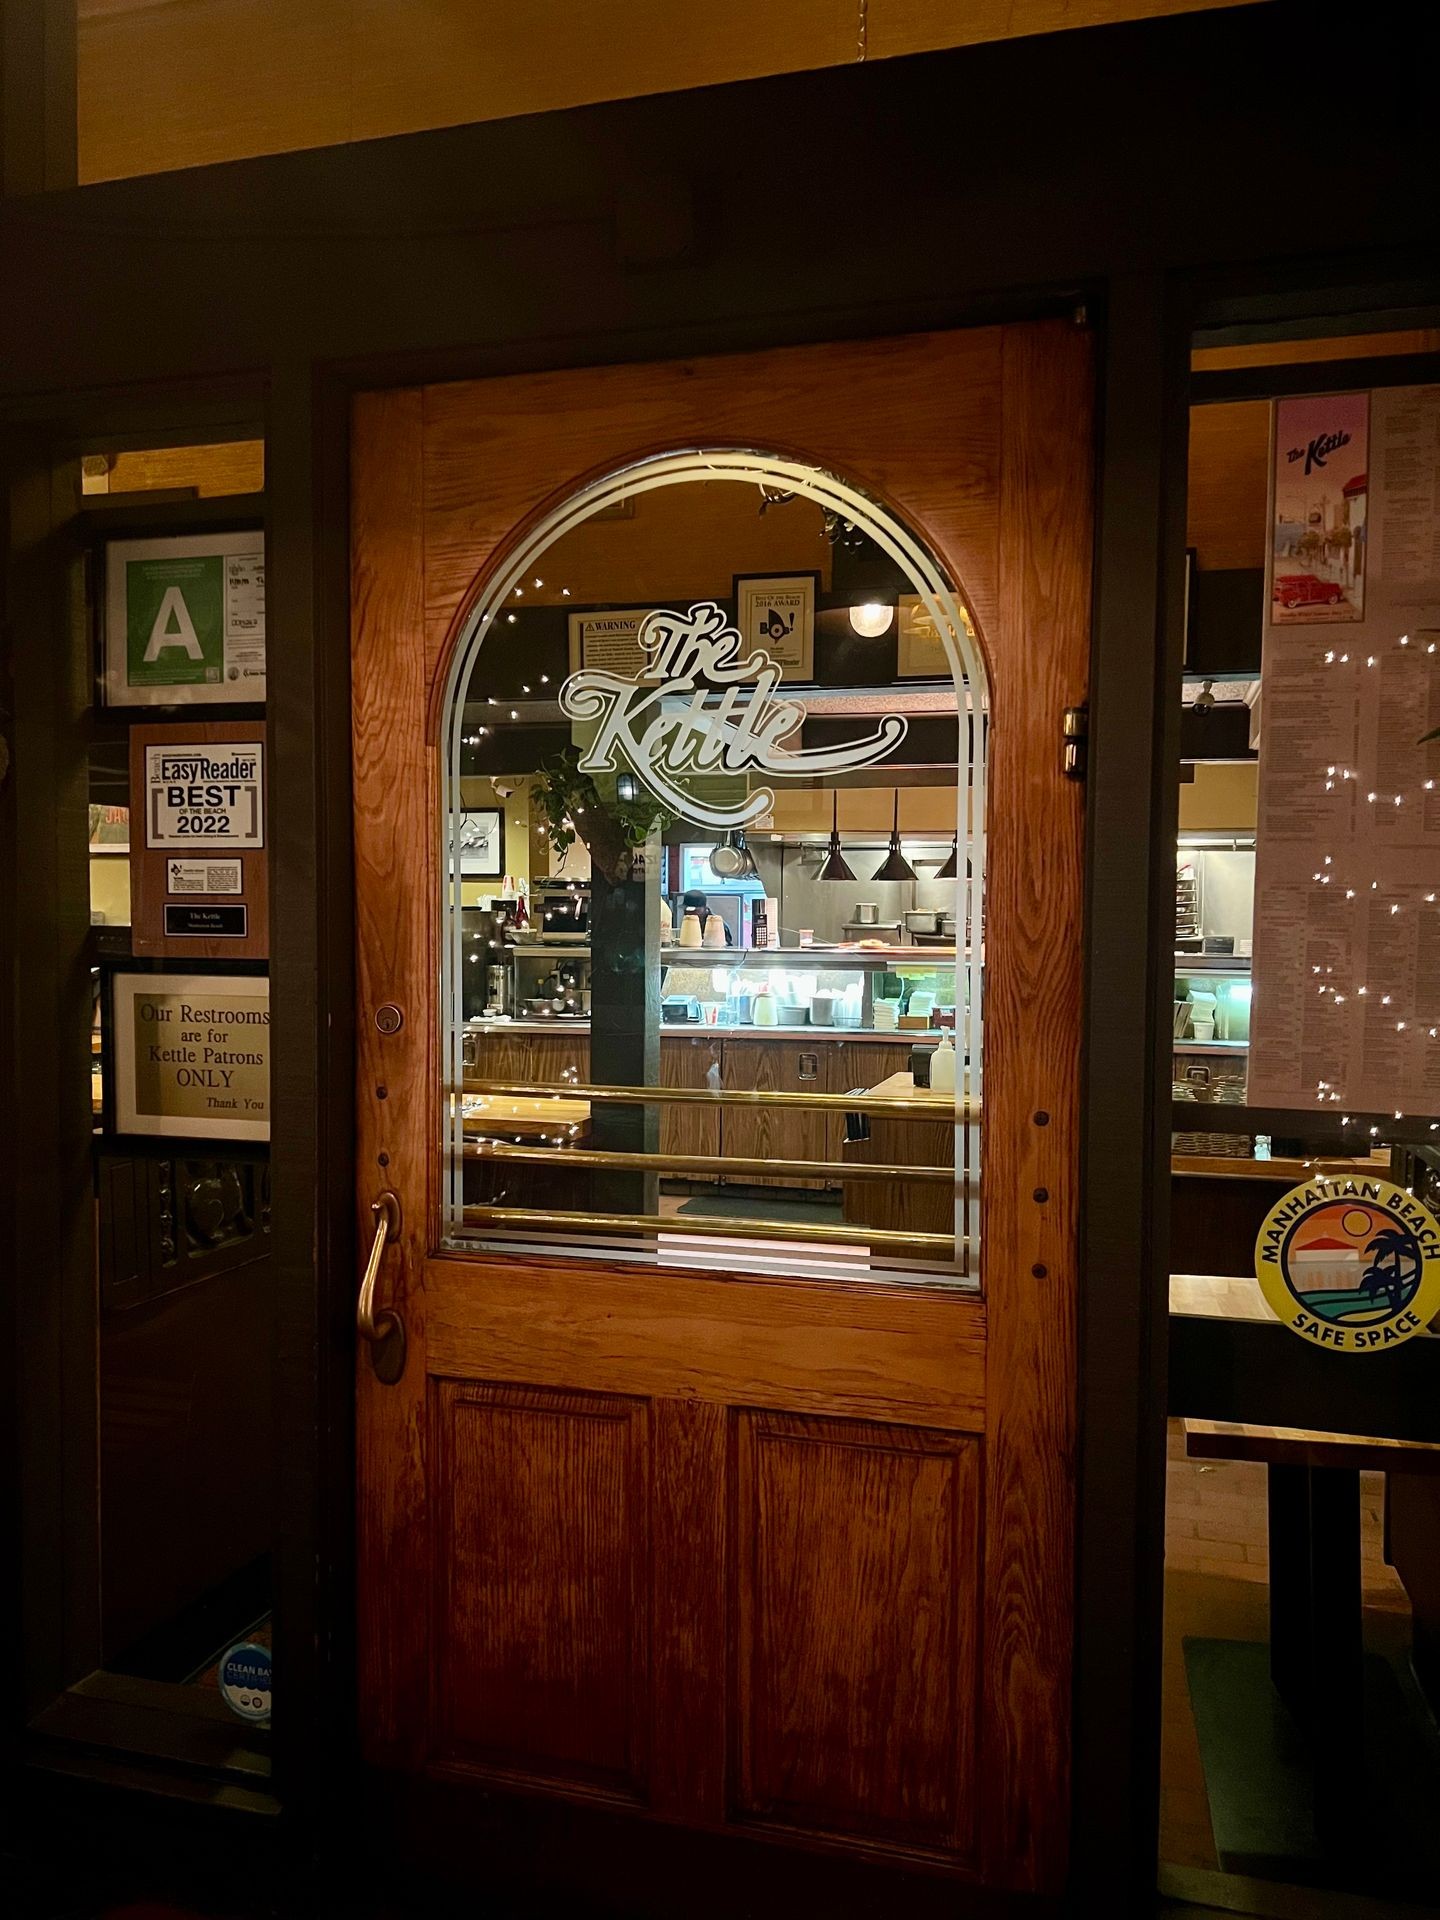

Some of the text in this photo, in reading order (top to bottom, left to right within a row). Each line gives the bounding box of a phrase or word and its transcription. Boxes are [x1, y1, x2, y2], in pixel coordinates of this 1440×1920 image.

[1286, 430, 1353, 475] The Kettle
[143, 586, 204, 662] A
[595, 620, 636, 630] WARNING
[638, 602, 770, 683] The
[559, 662, 907, 830] Kettle
[167, 785, 241, 807] BEST
[203, 807, 227, 815] BEACH
[177, 815, 230, 834] 2022
[141, 1003, 270, 1025] Our Restrooms
[181, 1029, 229, 1044] are for
[149, 1045, 264, 1066] Kettle Patrons
[176, 1068, 235, 1088] ONLY
[206, 1097, 264, 1111] Thank You
[1262, 1181, 1440, 1264] MANHATTAN BEACH
[1292, 1310, 1422, 1348] SAFE SPACE
[226, 1663, 256, 1675] CLEAN
